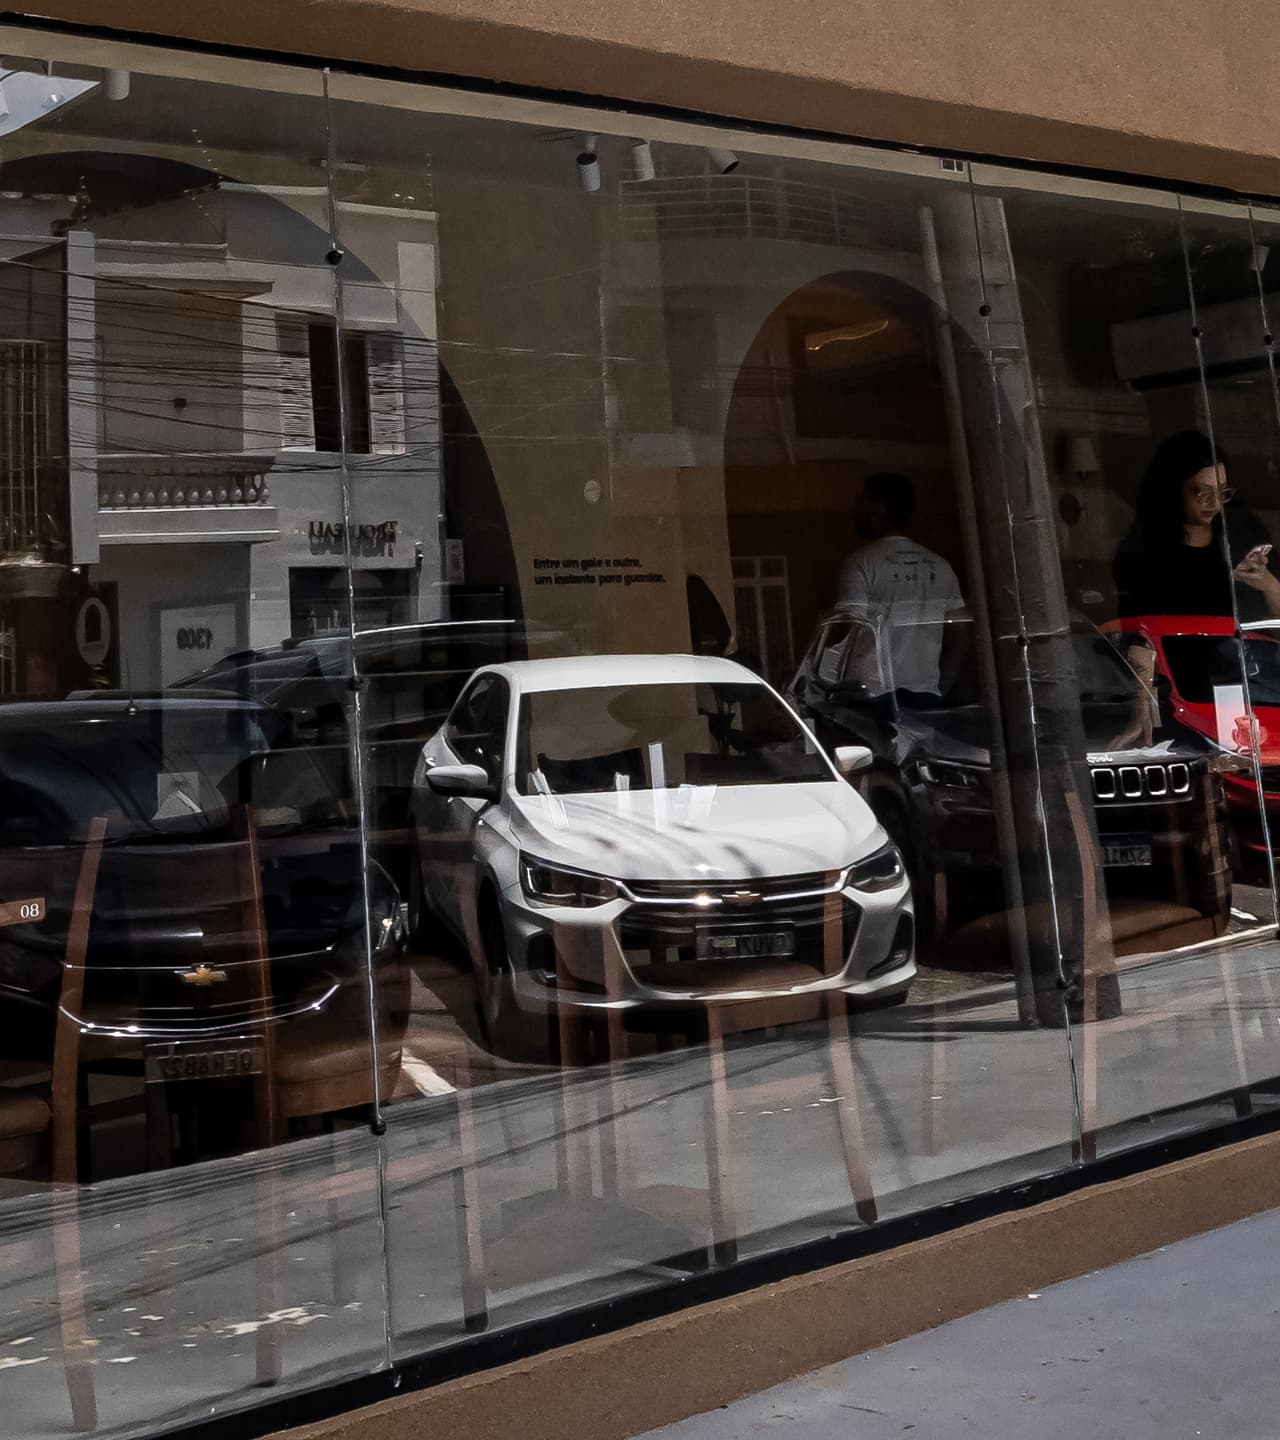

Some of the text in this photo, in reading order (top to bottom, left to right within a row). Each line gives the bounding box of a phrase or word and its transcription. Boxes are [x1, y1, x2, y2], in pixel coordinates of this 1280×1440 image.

[533, 558, 560, 569] Entre
[562, 559, 579, 569] um
[535, 575, 553, 585] um
[20, 903, 40, 919] 08
